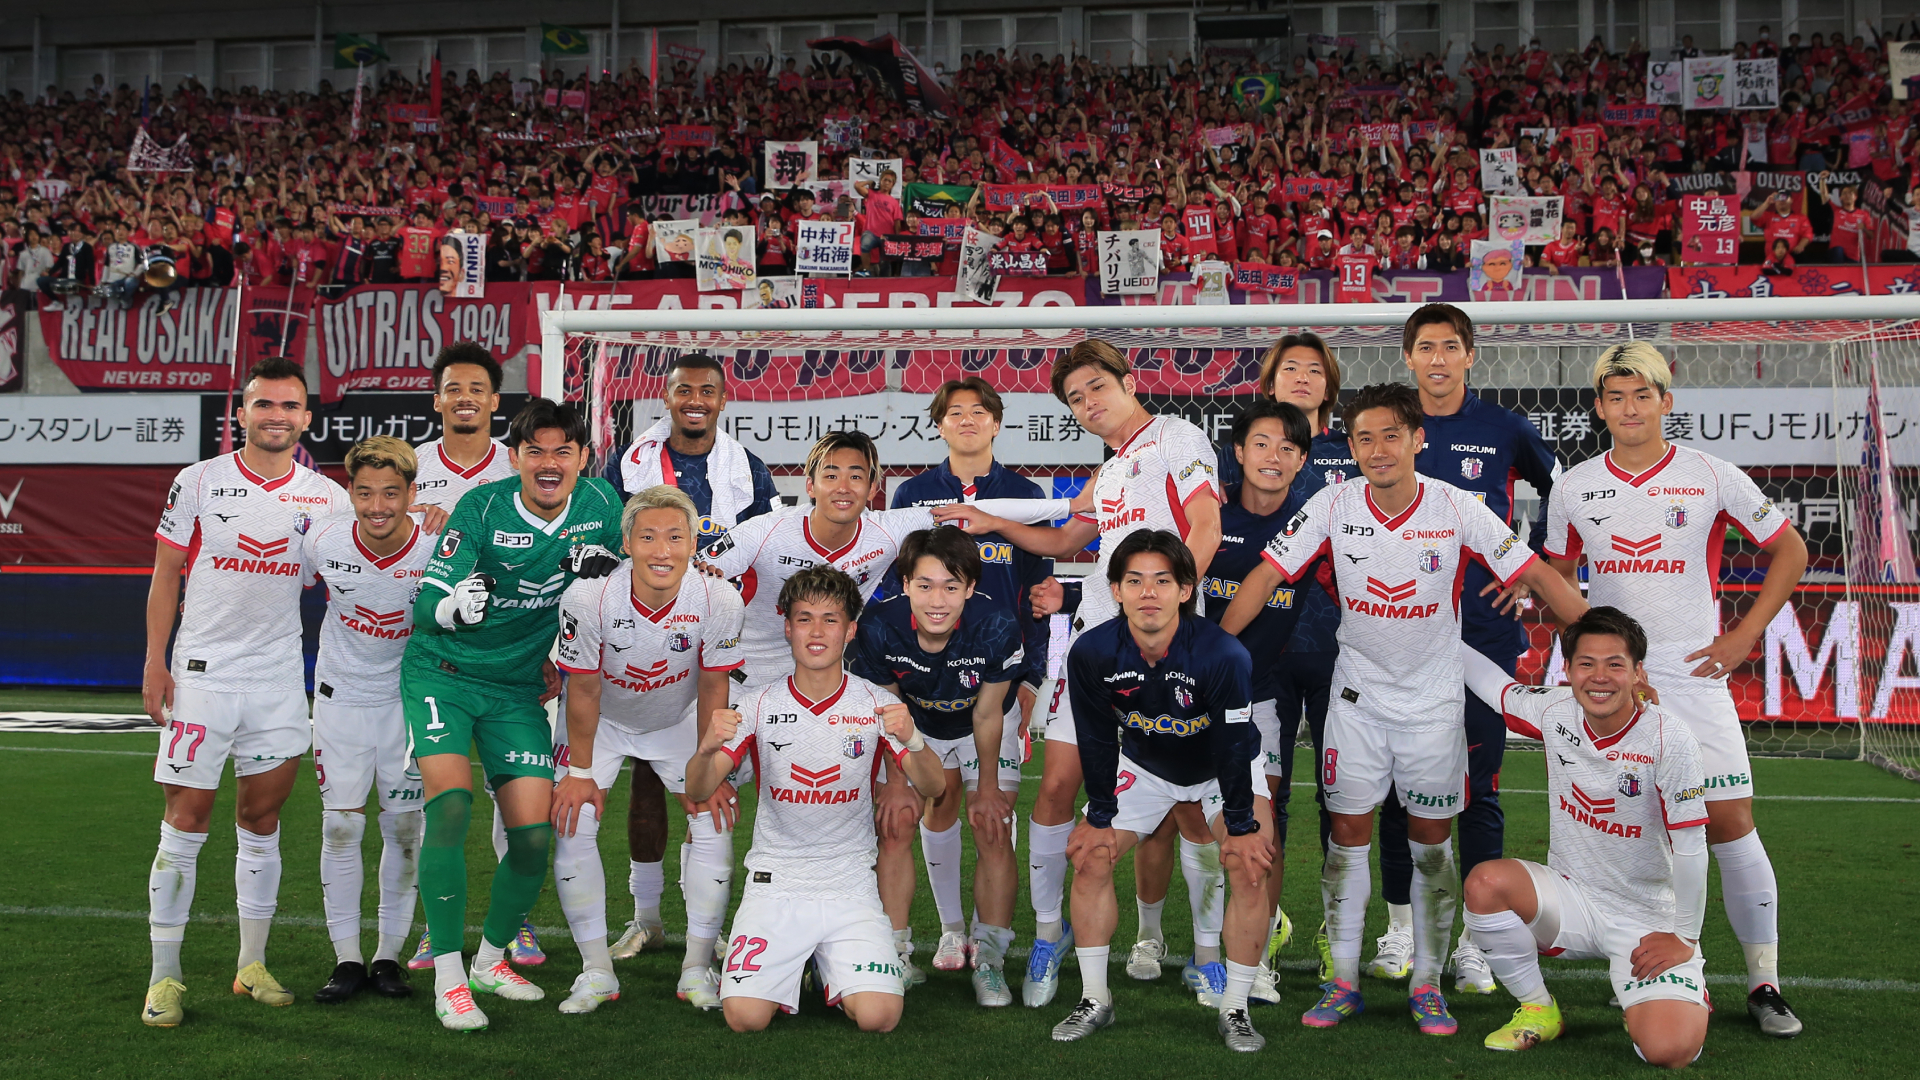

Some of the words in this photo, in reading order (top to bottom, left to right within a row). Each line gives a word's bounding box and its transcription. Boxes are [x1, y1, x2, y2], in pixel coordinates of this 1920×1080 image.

[1690, 198, 1727, 216] 中島
[1188, 214, 1211, 234] 44
[1698, 215, 1736, 232] 元彦
[801, 227, 837, 244] 中村
[408, 234, 430, 255] 33
[1716, 238, 1734, 254] 13
[466, 236, 479, 284] SHINJI
[812, 246, 850, 263] 拓海
[1343, 264, 1366, 286] 13
[468, 285, 475, 295] 8
[450, 303, 511, 355] 1994
[103, 370, 163, 385] NEVER
[166, 372, 213, 386] STOP
[386, 376, 432, 390] GIVE
[1450, 444, 1497, 455] KOIZUMI
[211, 486, 248, 499] ヨドコウ
[292, 494, 328, 506] NIKKON
[1581, 489, 1616, 502] ヨドコウ
[1663, 487, 1705, 496] NIKKON
[922, 498, 959, 506] YANMAR
[495, 532, 532, 545] ヨドコウ
[1342, 523, 1375, 537] ヨドコウ
[1417, 528, 1455, 539] NIKKON
[777, 554, 814, 568] ヨドコウ
[851, 547, 884, 567] NIKKON
[211, 556, 301, 577] YANMAR
[326, 559, 362, 574] ヨドコウ
[1594, 559, 1686, 574] YANMAR
[1345, 596, 1440, 619] YANMAR
[602, 668, 690, 692] YANMAR
[425, 697, 445, 730] 1
[168, 720, 207, 763] 77
[1555, 722, 1582, 747] ヨドコウ
[1324, 747, 1339, 785] 8
[770, 786, 859, 805] YANMAR
[1559, 795, 1642, 838] YANMAR
[726, 934, 769, 973] 22
